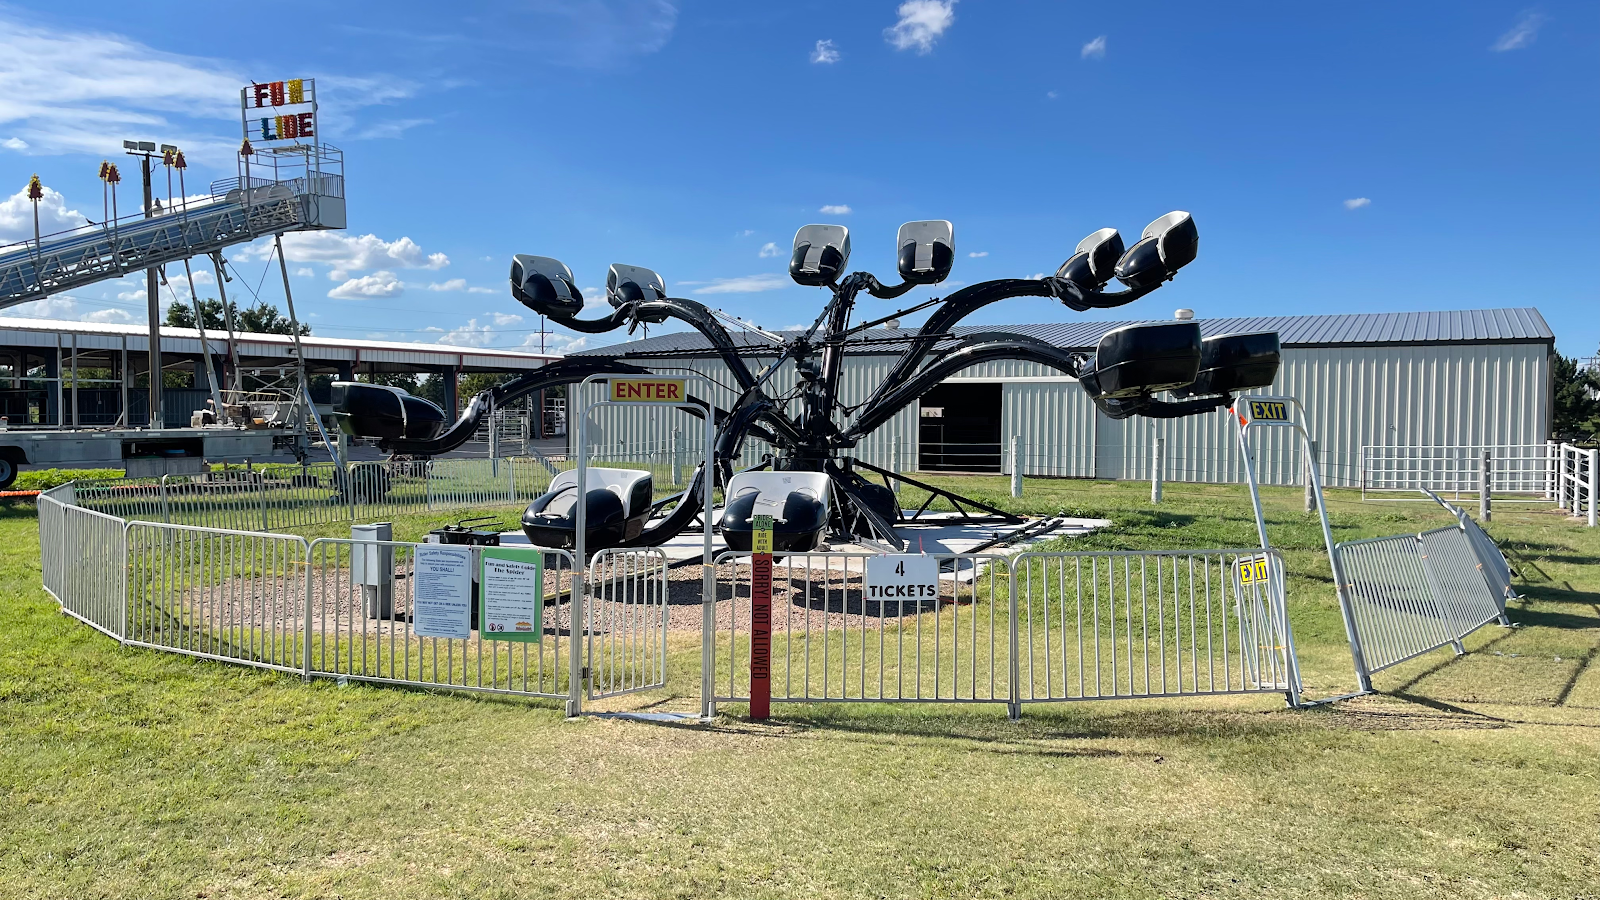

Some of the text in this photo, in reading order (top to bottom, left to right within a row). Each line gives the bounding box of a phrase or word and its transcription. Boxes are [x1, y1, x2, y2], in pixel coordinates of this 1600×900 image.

[254, 79, 304, 108] FUN
[616, 382, 679, 399] ENTER
[1251, 402, 1284, 419] EXIT
[755, 520, 771, 528] ALONE
[506, 568, 525, 576] Spider
[895, 560, 905, 577] 4
[869, 584, 936, 598] TICKETS
[752, 559, 770, 679] SORRY! NOT ALLOWED
